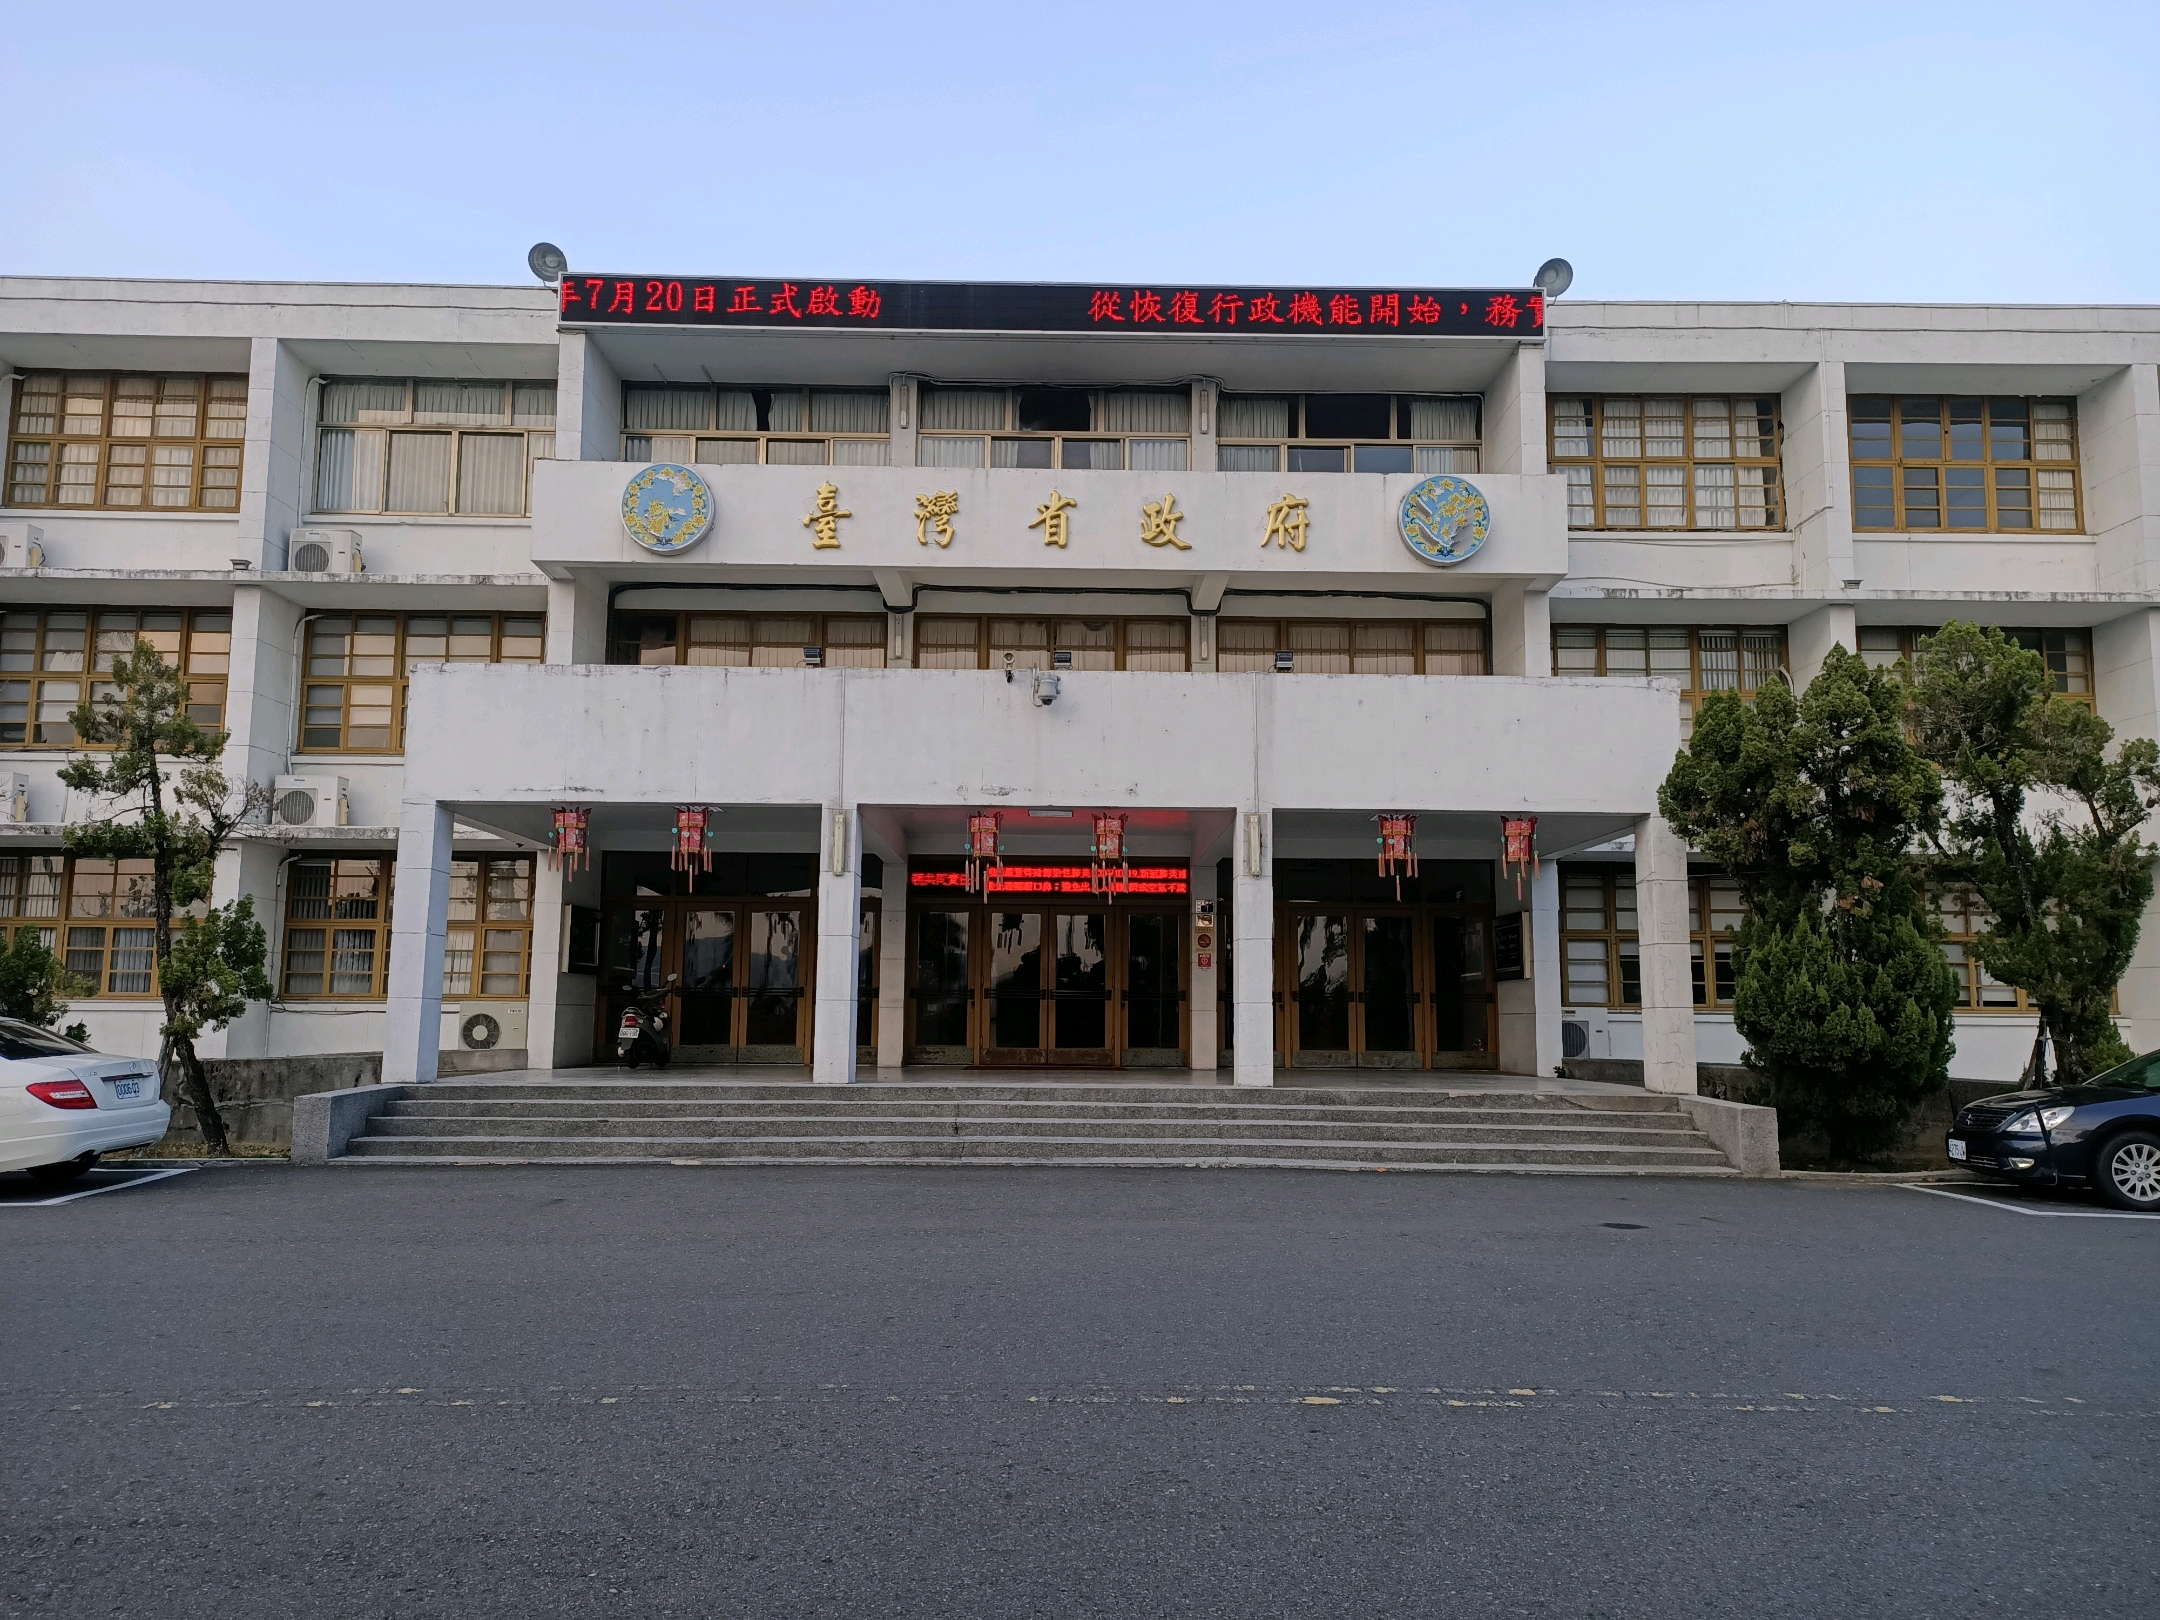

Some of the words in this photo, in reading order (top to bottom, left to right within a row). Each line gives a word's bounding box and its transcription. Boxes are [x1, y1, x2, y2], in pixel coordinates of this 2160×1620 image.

[805, 484, 1308, 551] 臺灣省政府
